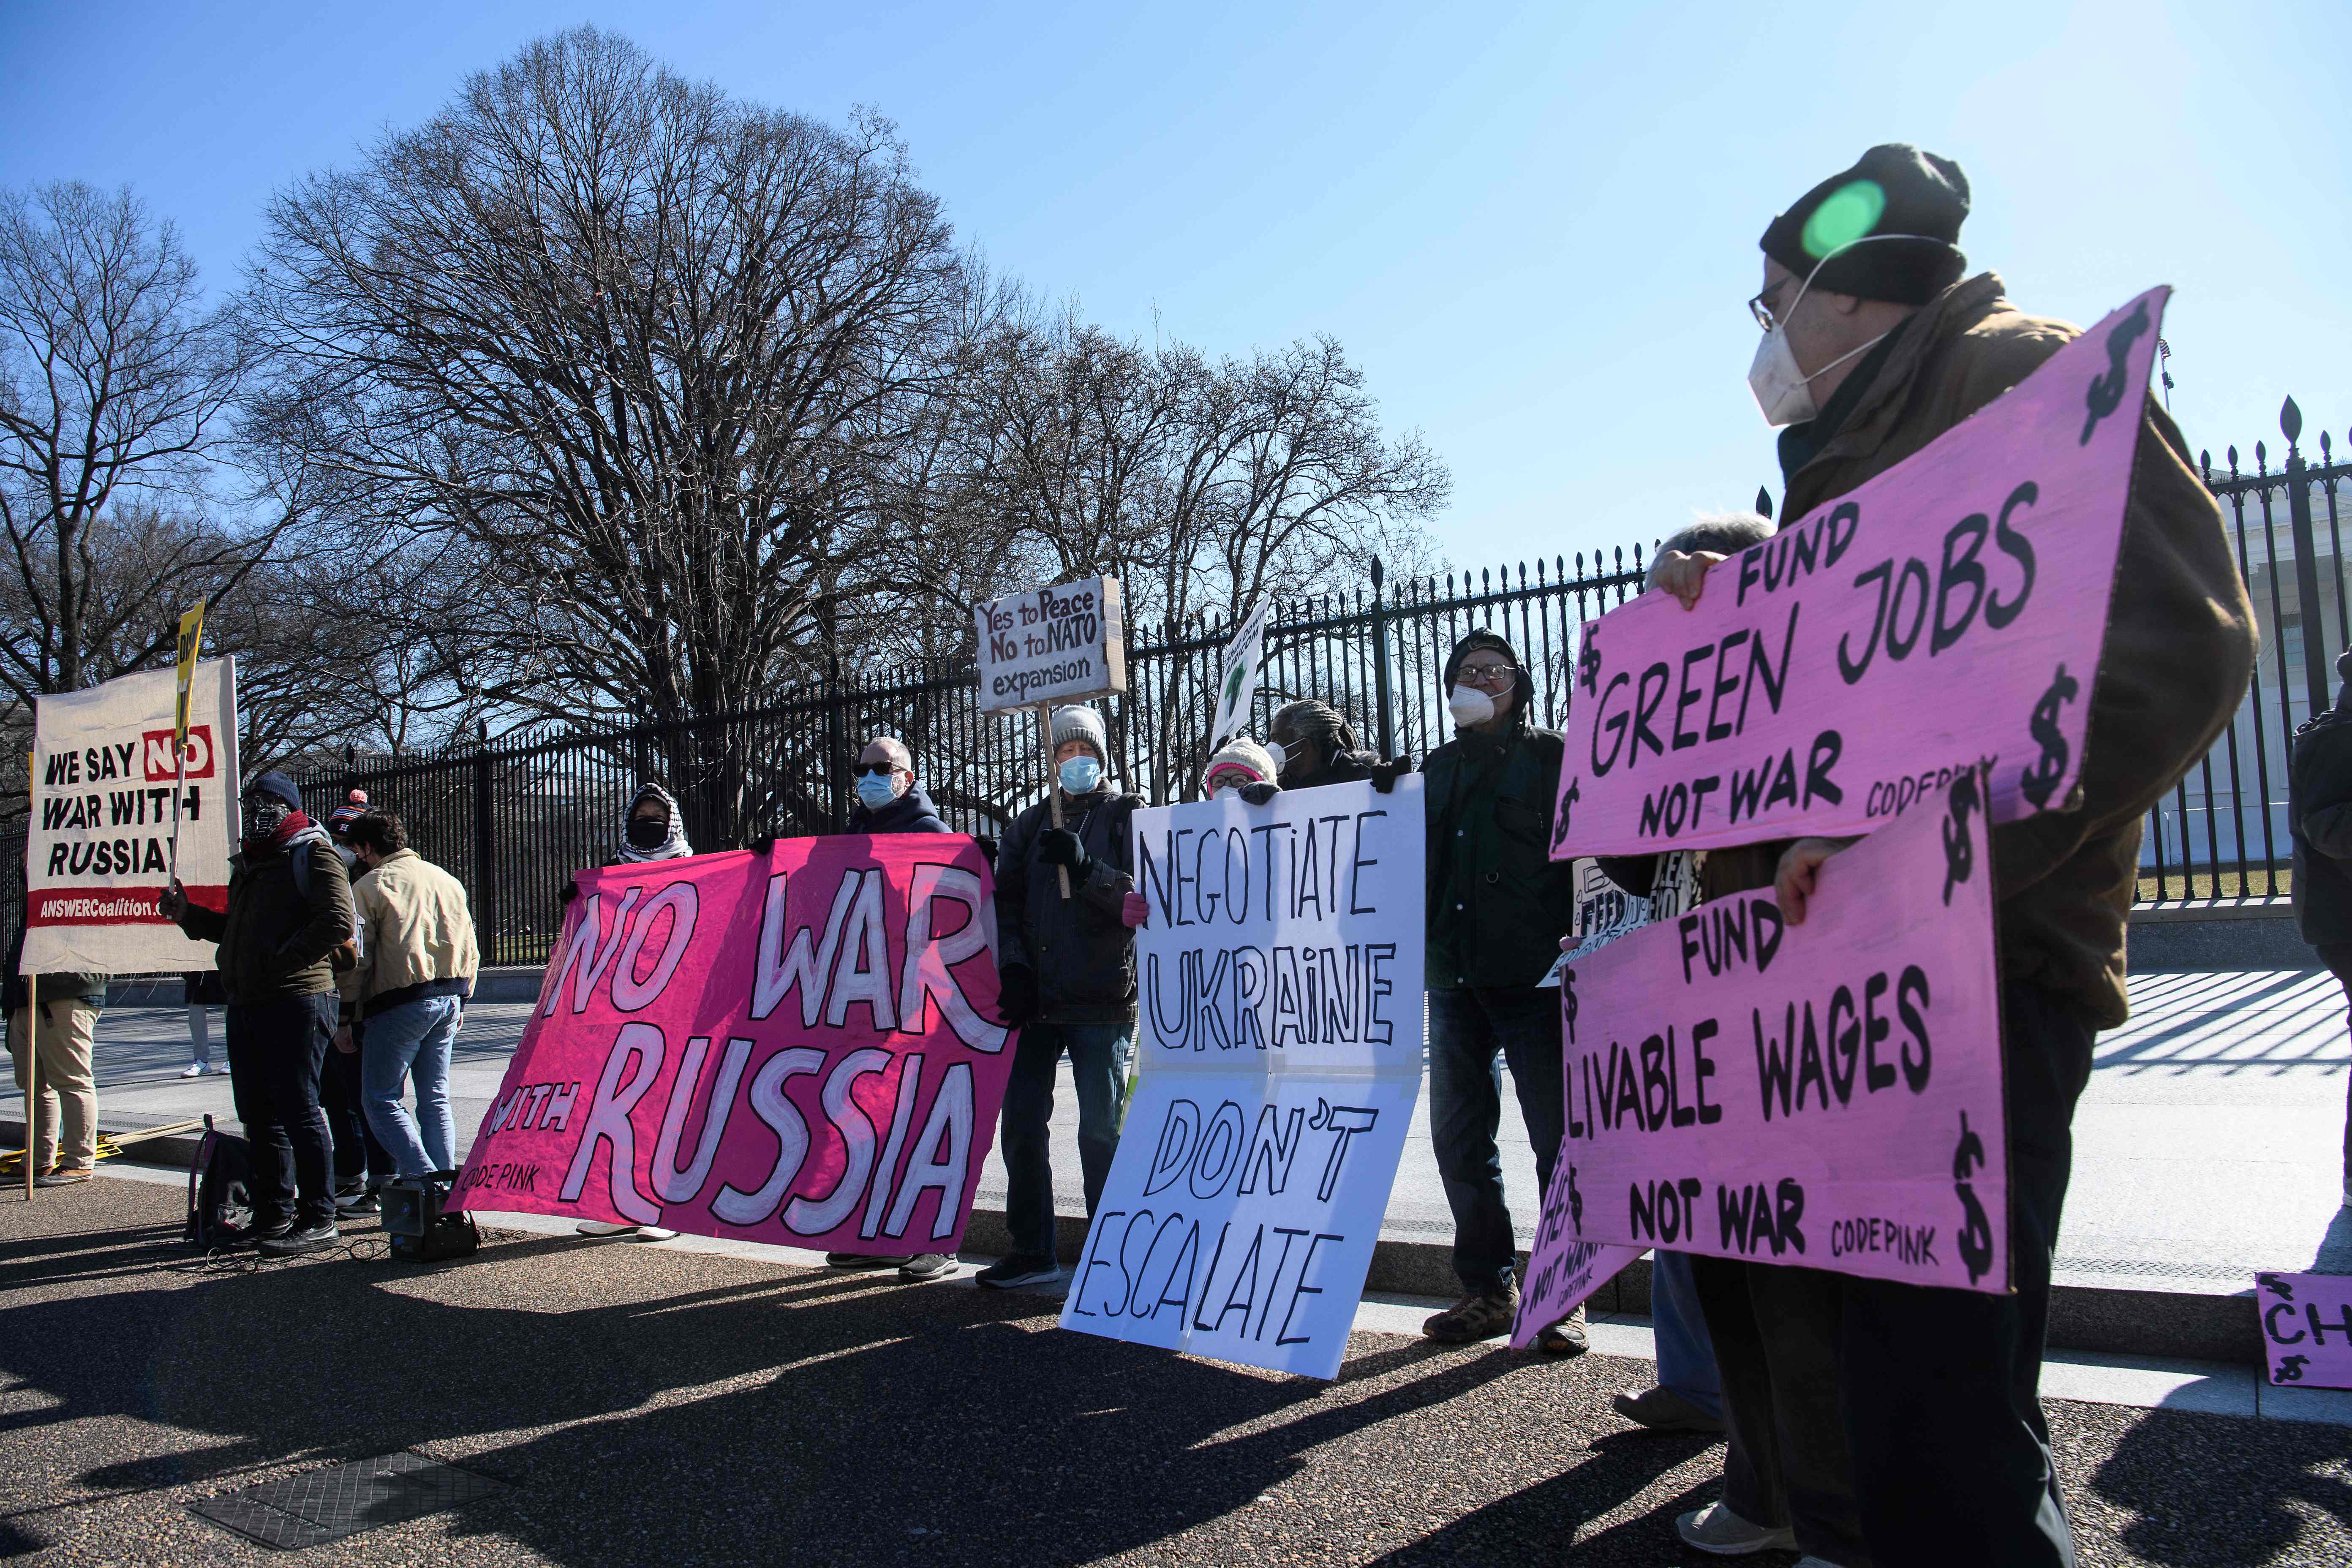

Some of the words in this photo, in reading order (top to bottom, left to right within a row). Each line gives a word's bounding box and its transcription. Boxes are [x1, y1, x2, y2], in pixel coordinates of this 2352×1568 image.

[1737, 501, 1860, 606] FUND
[977, 602, 1014, 634] Yes
[1018, 602, 1038, 626] to
[1038, 590, 1094, 622] Peace
[991, 632, 1017, 664] No
[1024, 634, 1045, 658] to
[1046, 612, 1097, 653] NATO
[1225, 625, 1259, 678] AFRICOM
[1591, 601, 1799, 776] GREEN
[1838, 480, 2038, 685] JOBS
[993, 657, 1091, 701] expansion
[45, 751, 81, 785] WE
[86, 742, 135, 782] SAY
[147, 734, 209, 774] NO
[1639, 776, 1719, 838] NOT
[1730, 730, 1842, 824] WAR
[43, 794, 102, 830] WAR
[109, 786, 200, 826] WITH
[543, 880, 699, 1018] NO
[751, 863, 1013, 1054] WAR
[1679, 897, 1784, 984] FUND
[1566, 1018, 1722, 1141] LIVABLE
[1752, 965, 1931, 1122] WAGES
[486, 1082, 581, 1139] WITH
[558, 1021, 975, 1240] RUSSIA
[1143, 1097, 1378, 1203] DON'T
[1629, 1178, 1701, 1244] NOT
[1718, 1177, 1806, 1256] WAR
[1073, 1209, 1344, 1346] ESCALATE
[1529, 1251, 1564, 1315] NOT
